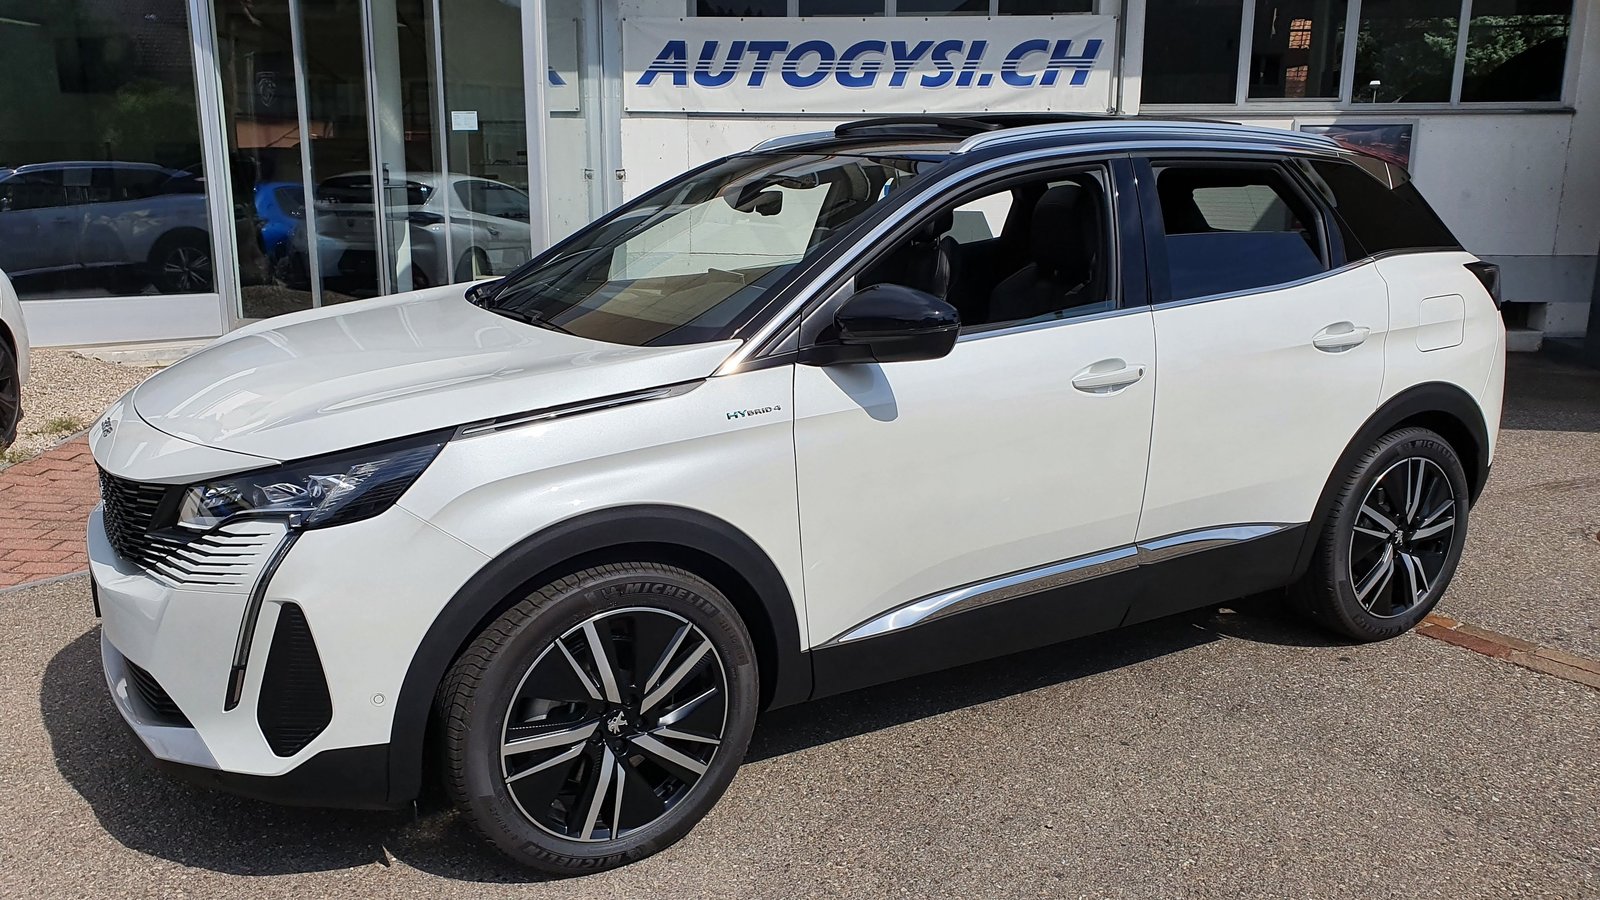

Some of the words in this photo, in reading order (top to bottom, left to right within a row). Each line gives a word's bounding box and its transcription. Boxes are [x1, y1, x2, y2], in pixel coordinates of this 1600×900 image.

[636, 39, 1104, 87] AUTOGYSI.CH
[625, 582, 719, 616] MICHELIN
[521, 842, 622, 869] MICHELIN
